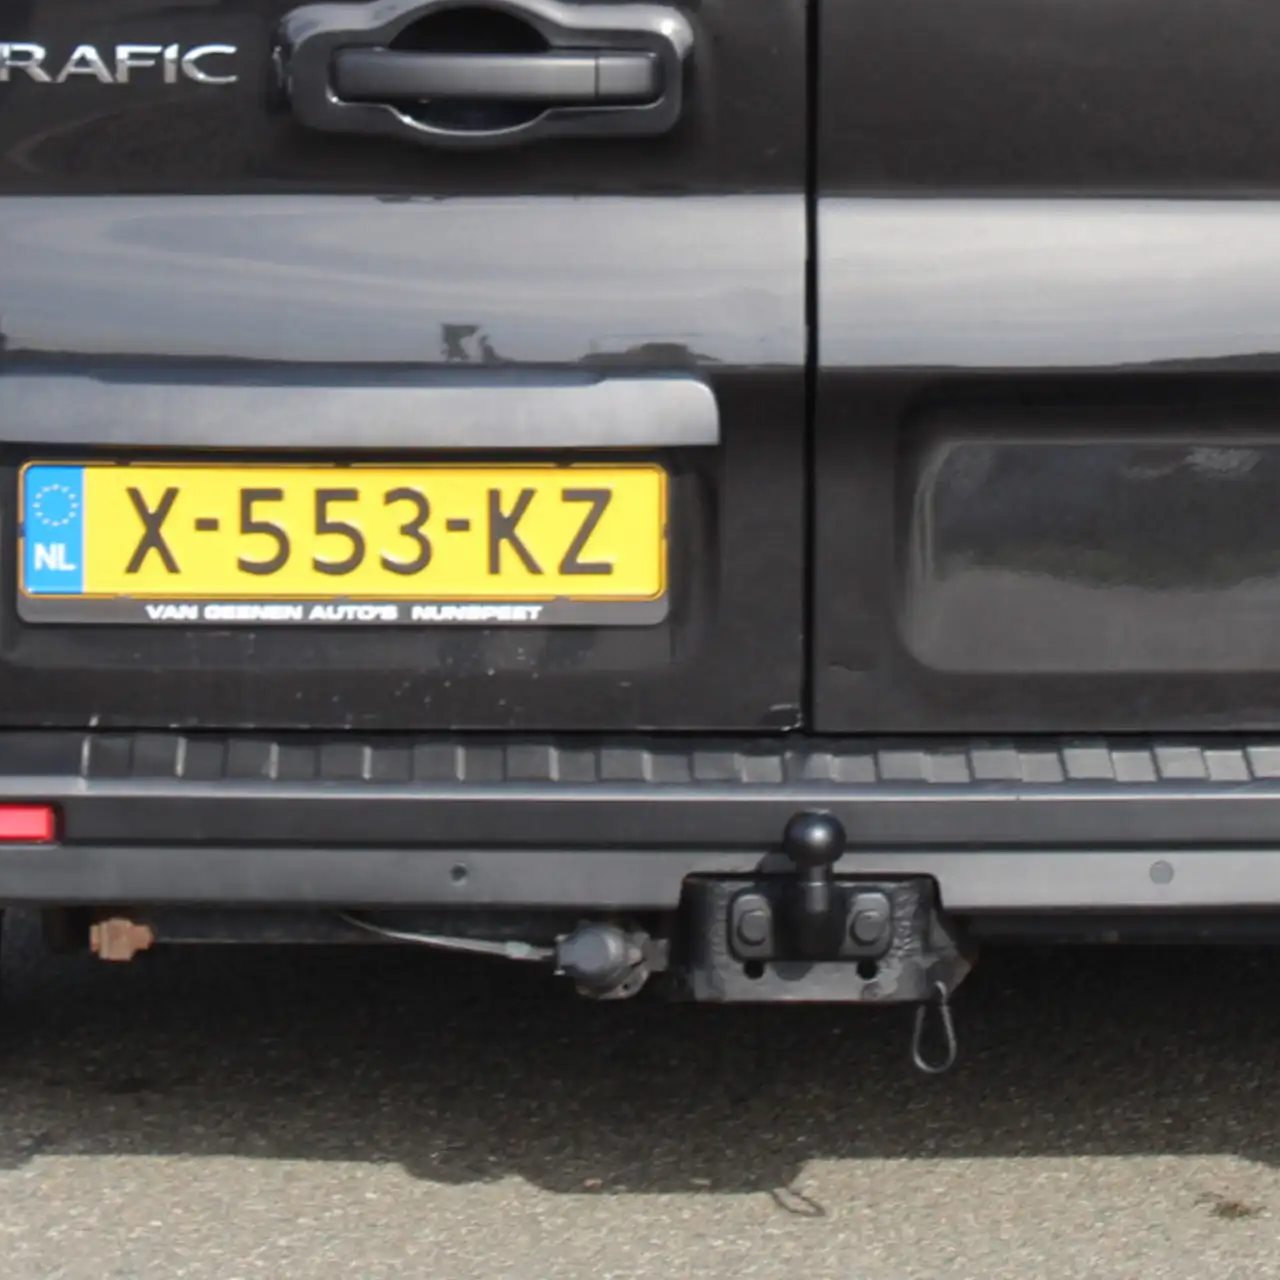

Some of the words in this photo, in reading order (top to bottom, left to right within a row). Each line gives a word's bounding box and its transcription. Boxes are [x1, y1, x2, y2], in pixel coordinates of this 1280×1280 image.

[125, 487, 614, 576] X-553-KZ
[34, 542, 77, 571] NL
[145, 604, 198, 620] VAN
[308, 604, 398, 620] AUTO'S
